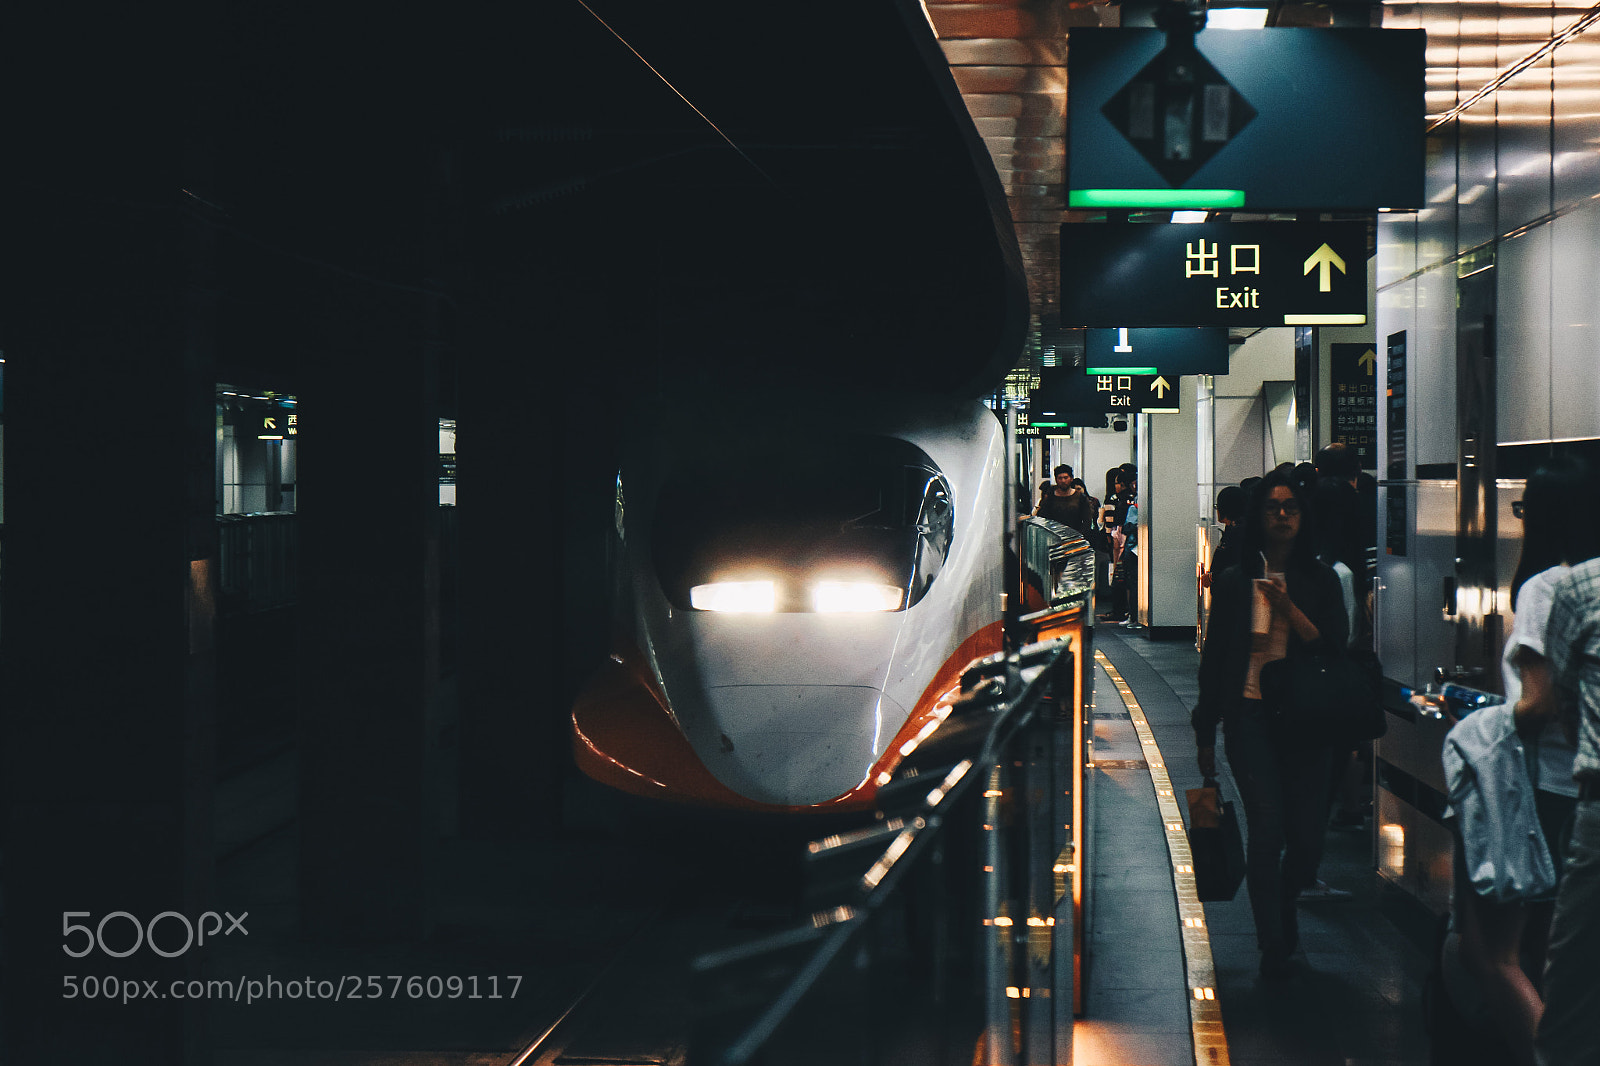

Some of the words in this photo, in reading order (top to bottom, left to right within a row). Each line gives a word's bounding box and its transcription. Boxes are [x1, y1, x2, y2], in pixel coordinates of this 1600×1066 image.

[1185, 238, 1260, 279] 出口
[1216, 287, 1260, 309] Exit
[1096, 375, 1132, 392] 出口
[1110, 395, 1131, 406] Exit
[1026, 426, 1040, 435] exit
